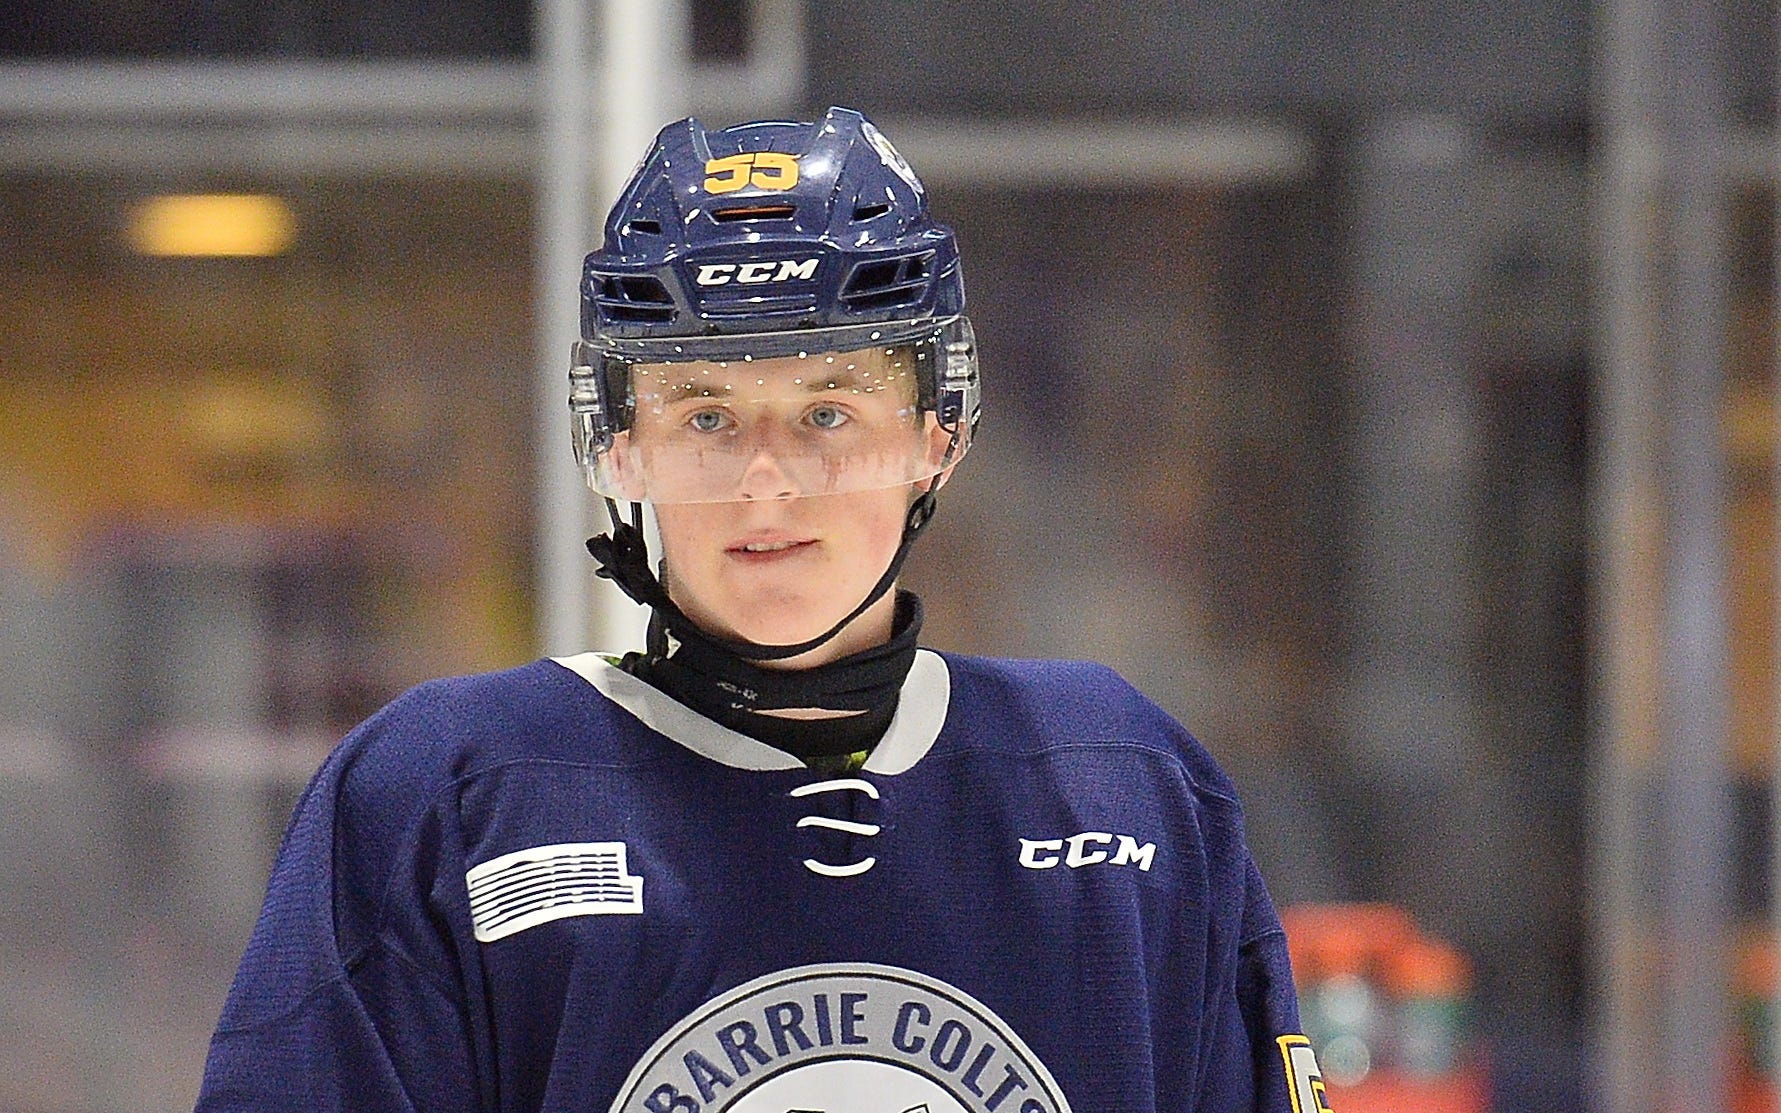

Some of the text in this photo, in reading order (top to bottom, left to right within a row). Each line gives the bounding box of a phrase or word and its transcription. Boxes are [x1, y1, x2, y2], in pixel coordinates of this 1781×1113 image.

[703, 152, 800, 195] 55
[696, 258, 820, 286] CCM
[1018, 831, 1157, 872] CCM
